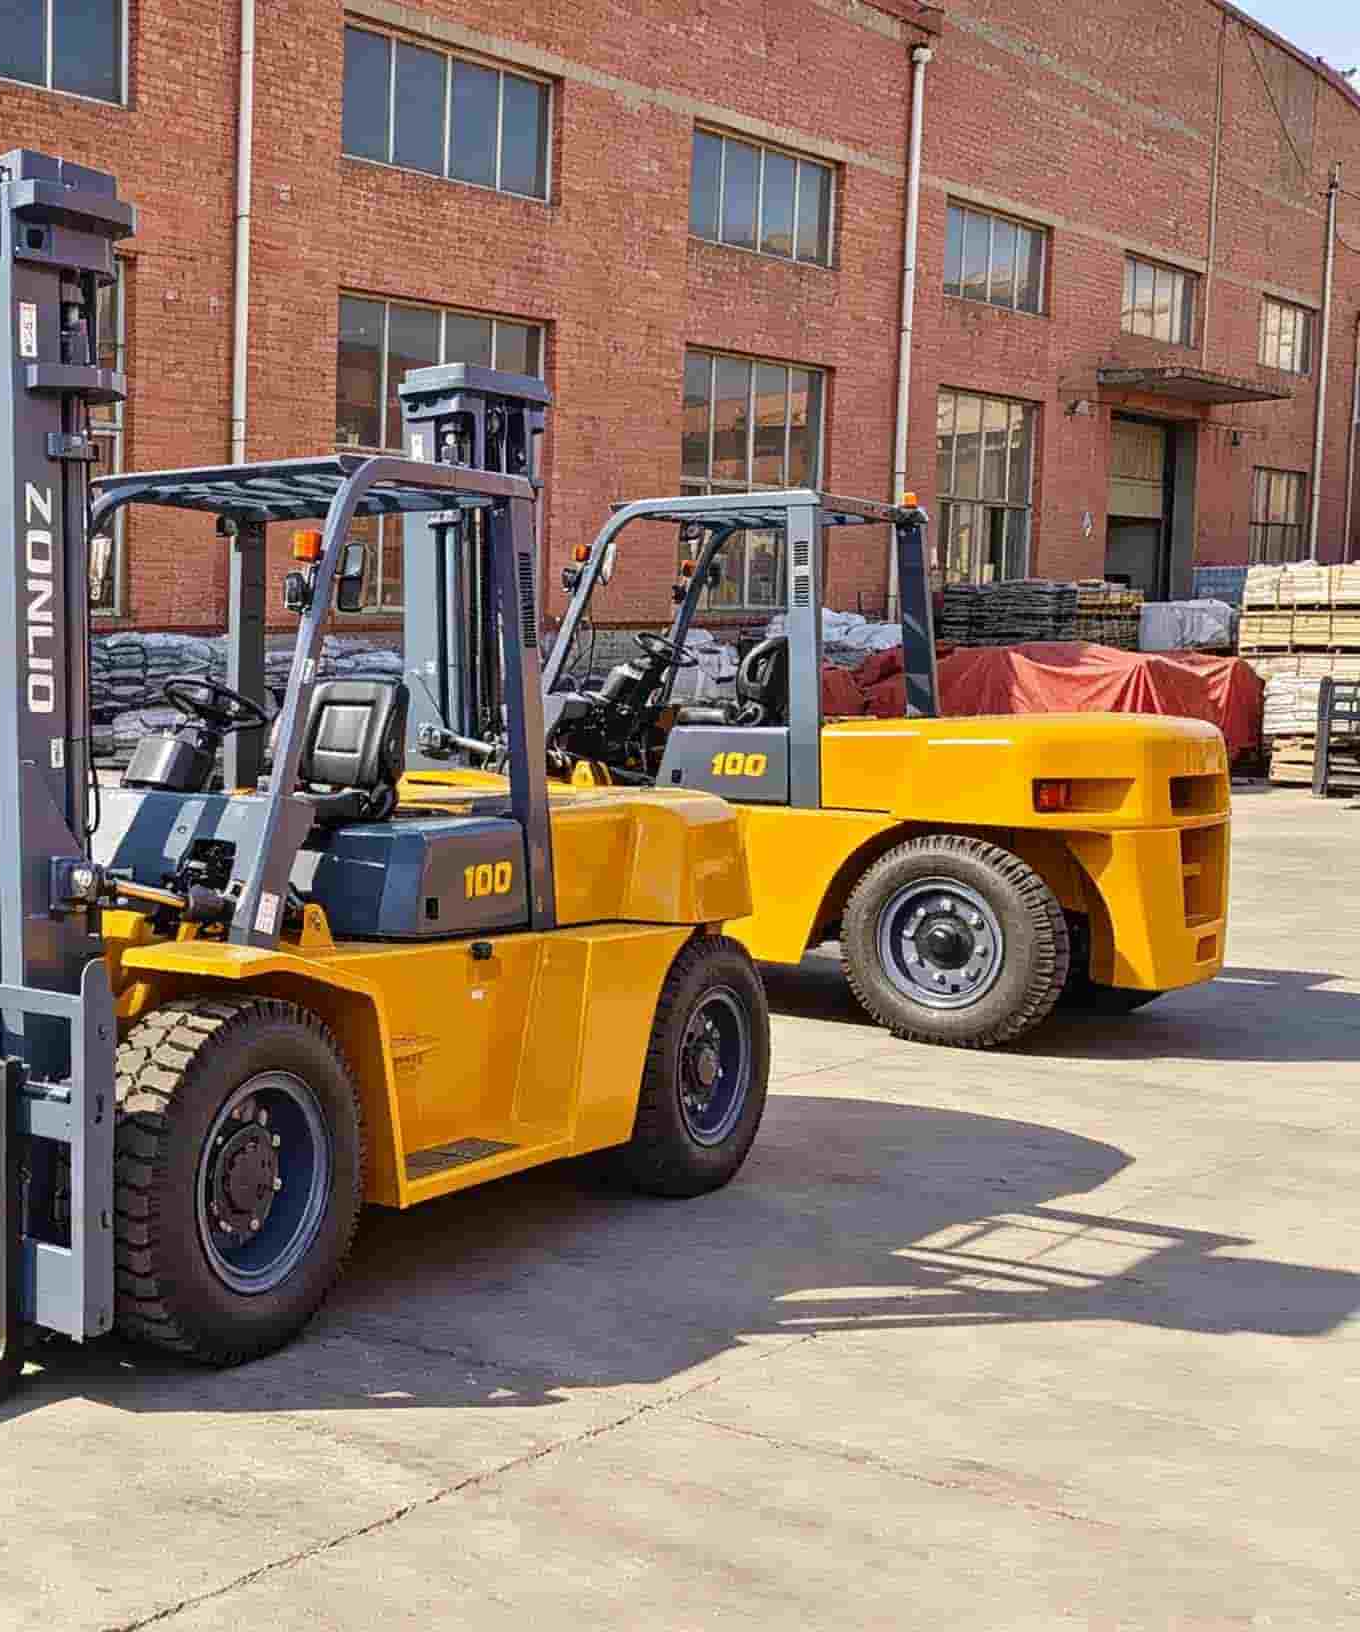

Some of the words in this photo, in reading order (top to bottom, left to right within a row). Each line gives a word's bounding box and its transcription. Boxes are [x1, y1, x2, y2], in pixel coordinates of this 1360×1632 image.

[24, 480, 55, 714] ZONLIO
[710, 751, 769, 778] 100
[463, 860, 514, 898] 100
